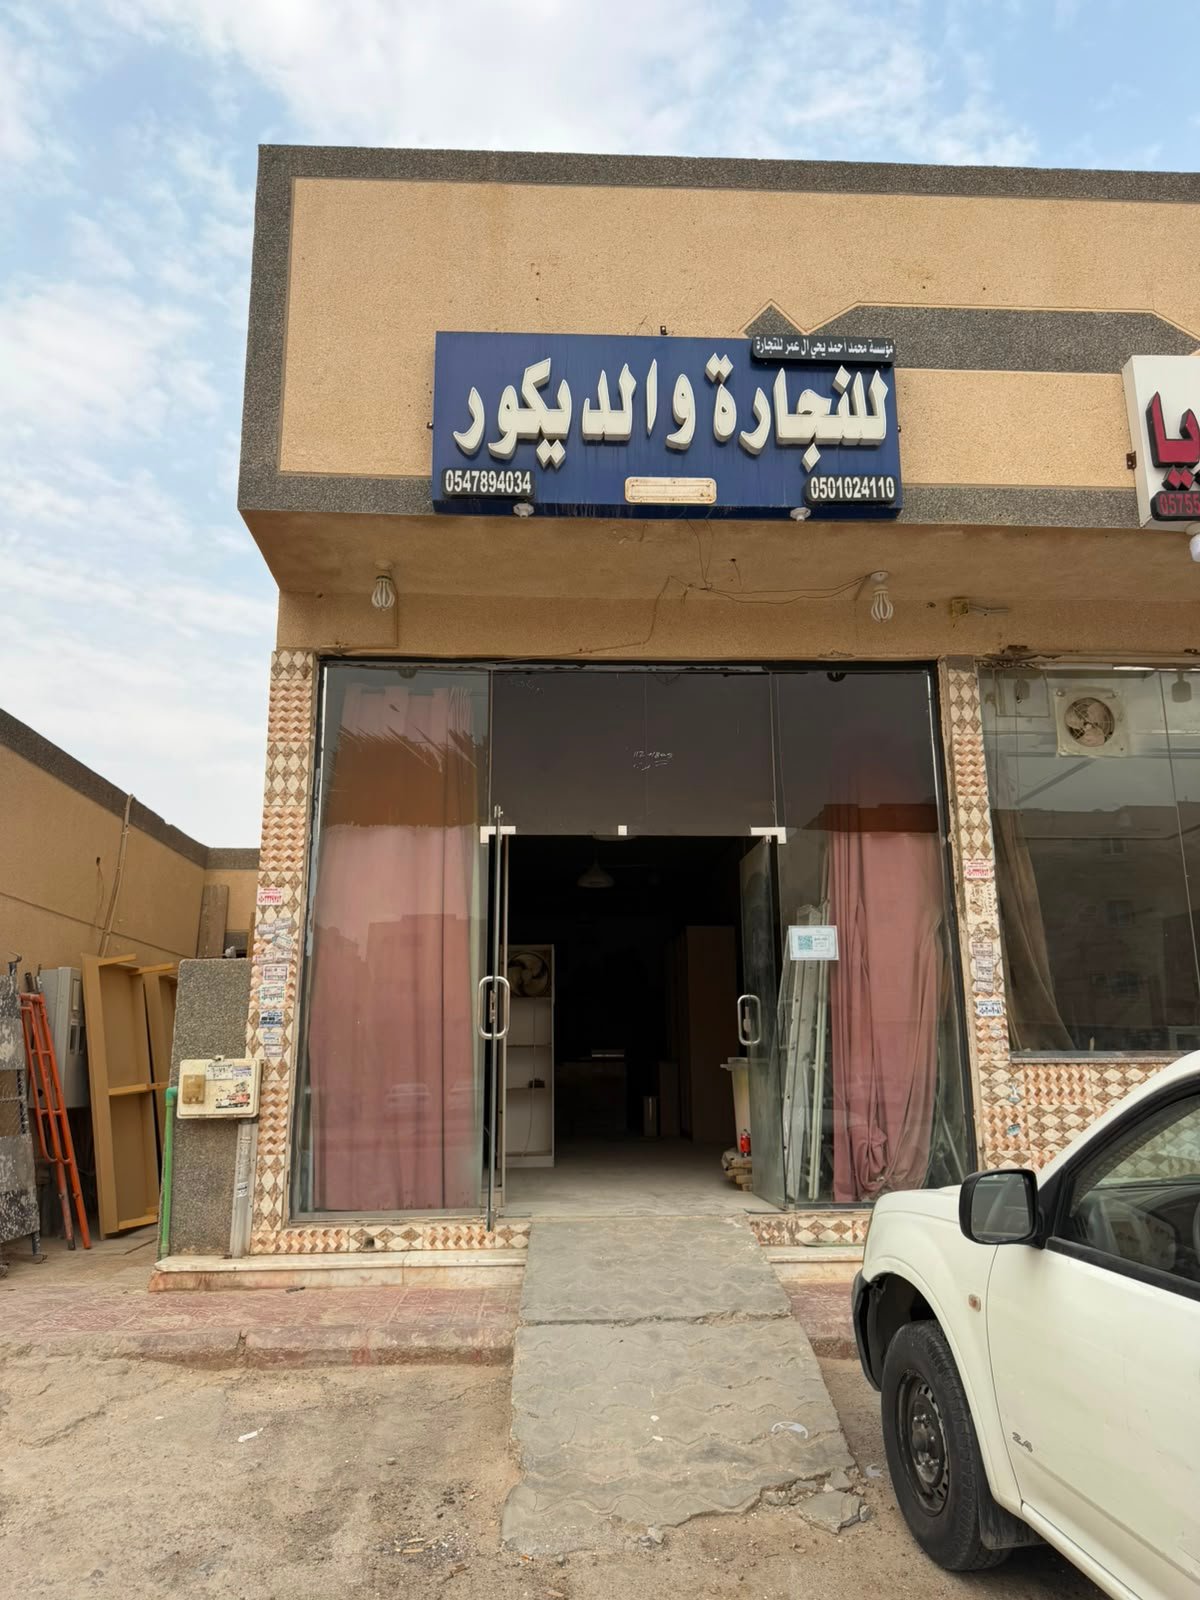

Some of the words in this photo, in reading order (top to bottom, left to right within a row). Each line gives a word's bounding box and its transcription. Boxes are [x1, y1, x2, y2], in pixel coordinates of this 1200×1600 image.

[755, 336, 783, 355] للتجارة
[785, 341, 800, 355] عمر
[848, 342, 867, 354] محمد
[868, 339, 894, 359] مؤسسة
[453, 357, 696, 470] والديكور
[705, 353, 889, 473] للنجارة
[445, 469, 532, 493] 0547894034
[810, 476, 895, 499] 0501024110
